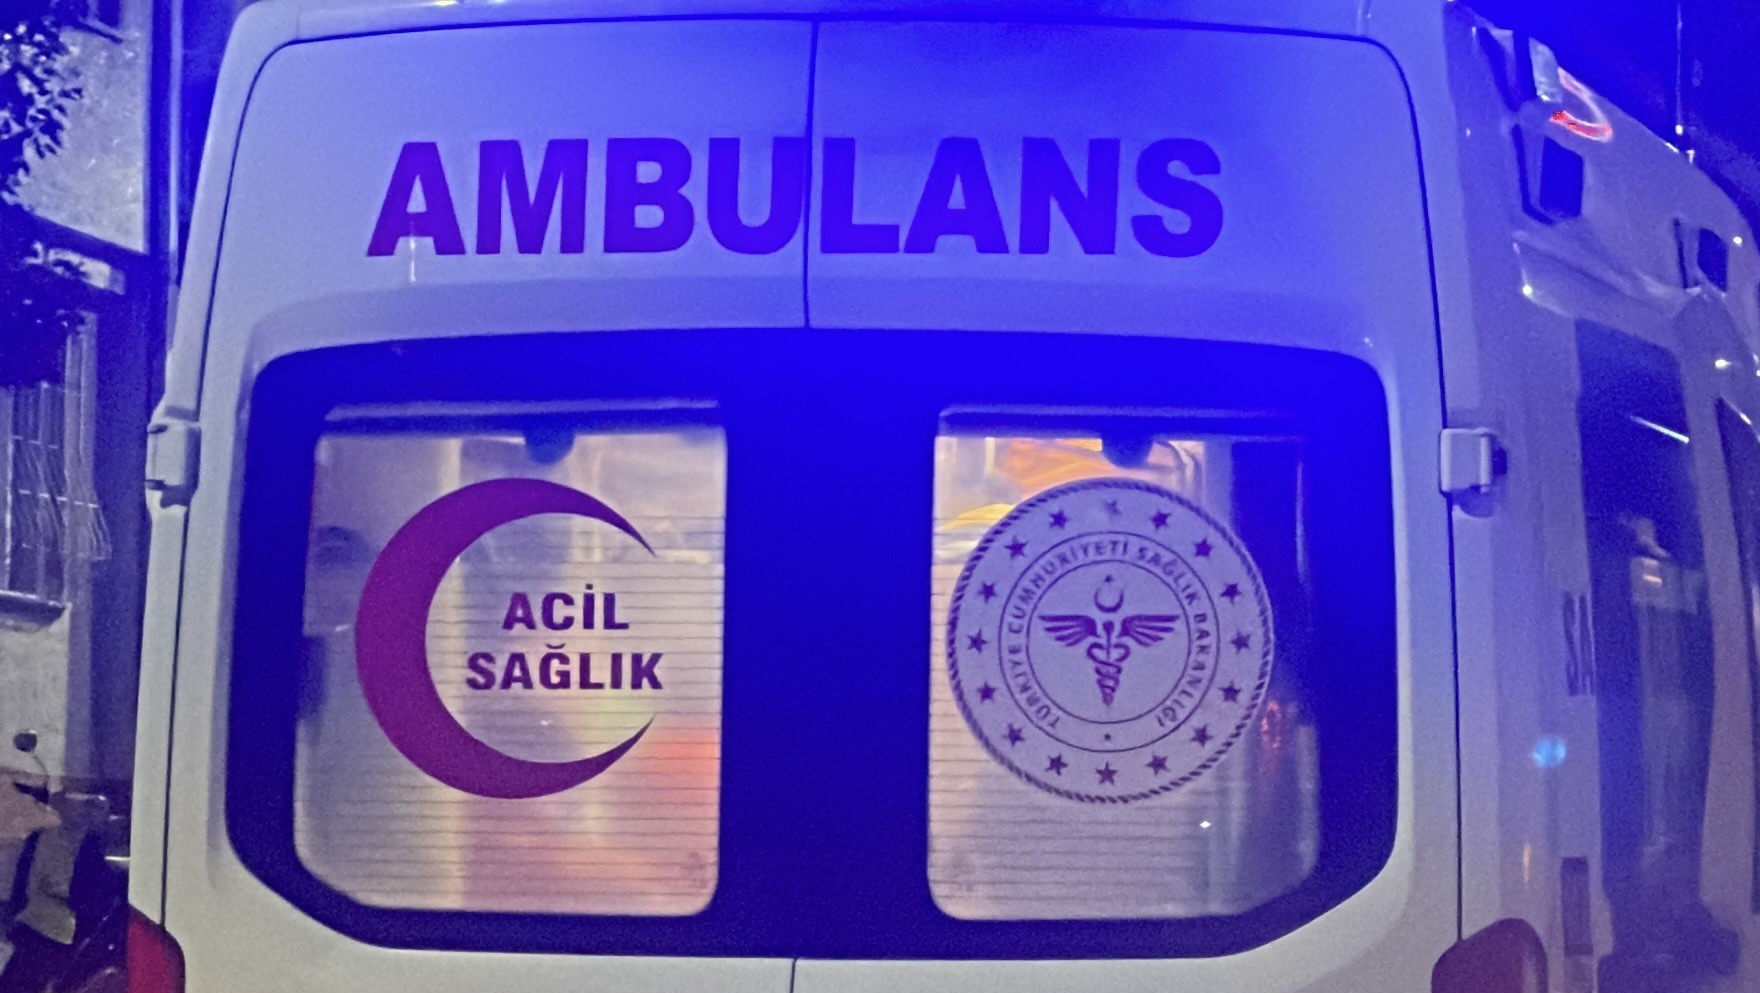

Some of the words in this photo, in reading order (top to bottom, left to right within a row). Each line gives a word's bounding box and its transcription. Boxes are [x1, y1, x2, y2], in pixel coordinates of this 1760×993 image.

[366, 136, 1224, 257] AMBULANS
[502, 583, 630, 631] ACİL
[465, 642, 664, 690] SAĞLIK
